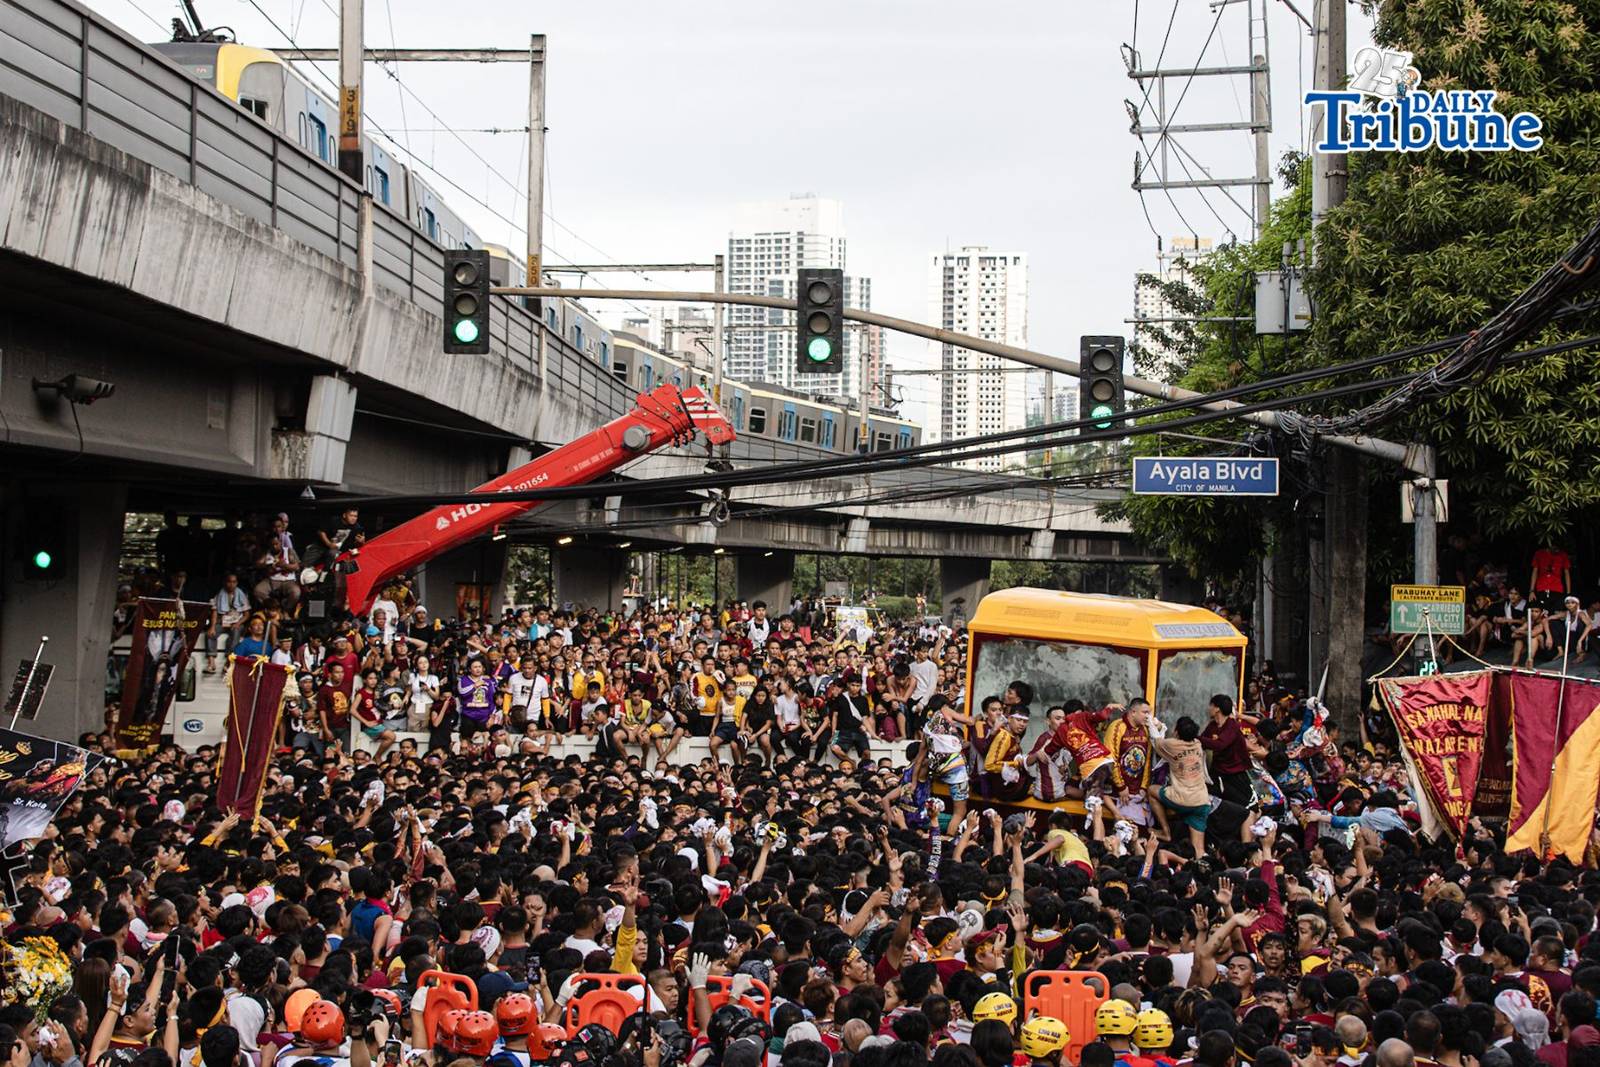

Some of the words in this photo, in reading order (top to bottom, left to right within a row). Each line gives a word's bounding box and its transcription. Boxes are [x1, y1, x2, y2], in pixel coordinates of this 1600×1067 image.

[346, 89, 355, 131] 349
[1150, 462, 1210, 485] Ayala
[1216, 462, 1263, 480] Blvd
[1175, 484, 1192, 492] CITY
[1195, 484, 1205, 492] OF
[1208, 484, 1236, 492] MANILA
[1439, 589, 1460, 597] LANE
[1443, 613, 1459, 622] CITY
[1406, 710, 1426, 728] SA
[1426, 704, 1460, 721] MAHAL
[1463, 705, 1482, 720] NA
